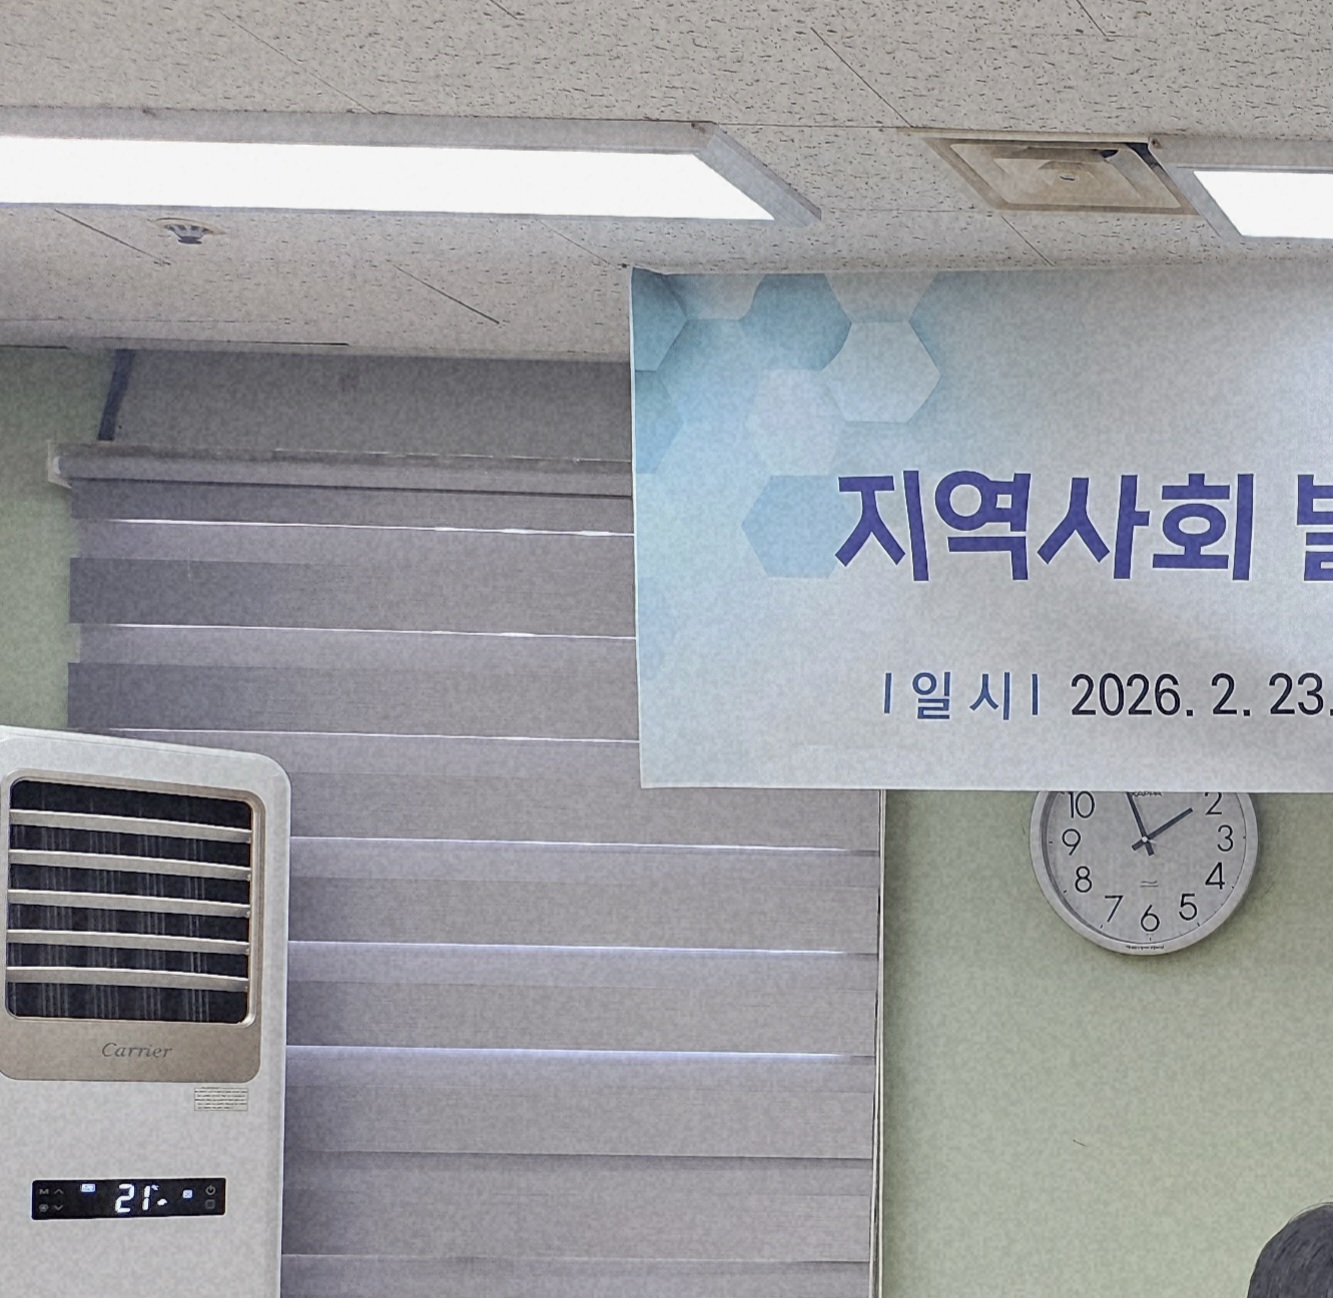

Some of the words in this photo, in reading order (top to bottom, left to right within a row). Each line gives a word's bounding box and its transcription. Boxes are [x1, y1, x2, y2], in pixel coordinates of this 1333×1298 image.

[834, 469, 1254, 582] 지역사회
[1070, 672, 1194, 717] 2026.
[1067, 791, 1096, 820] 10
[1205, 793, 1223, 816] 2
[1061, 828, 1082, 857] 9
[1216, 824, 1234, 853] 3
[1074, 865, 1093, 894] 8
[1204, 861, 1226, 890] 4
[1104, 894, 1125, 923] 7
[1140, 904, 1161, 933] 6
[1178, 892, 1199, 922] 5
[101, 1042, 174, 1060] Carrier
